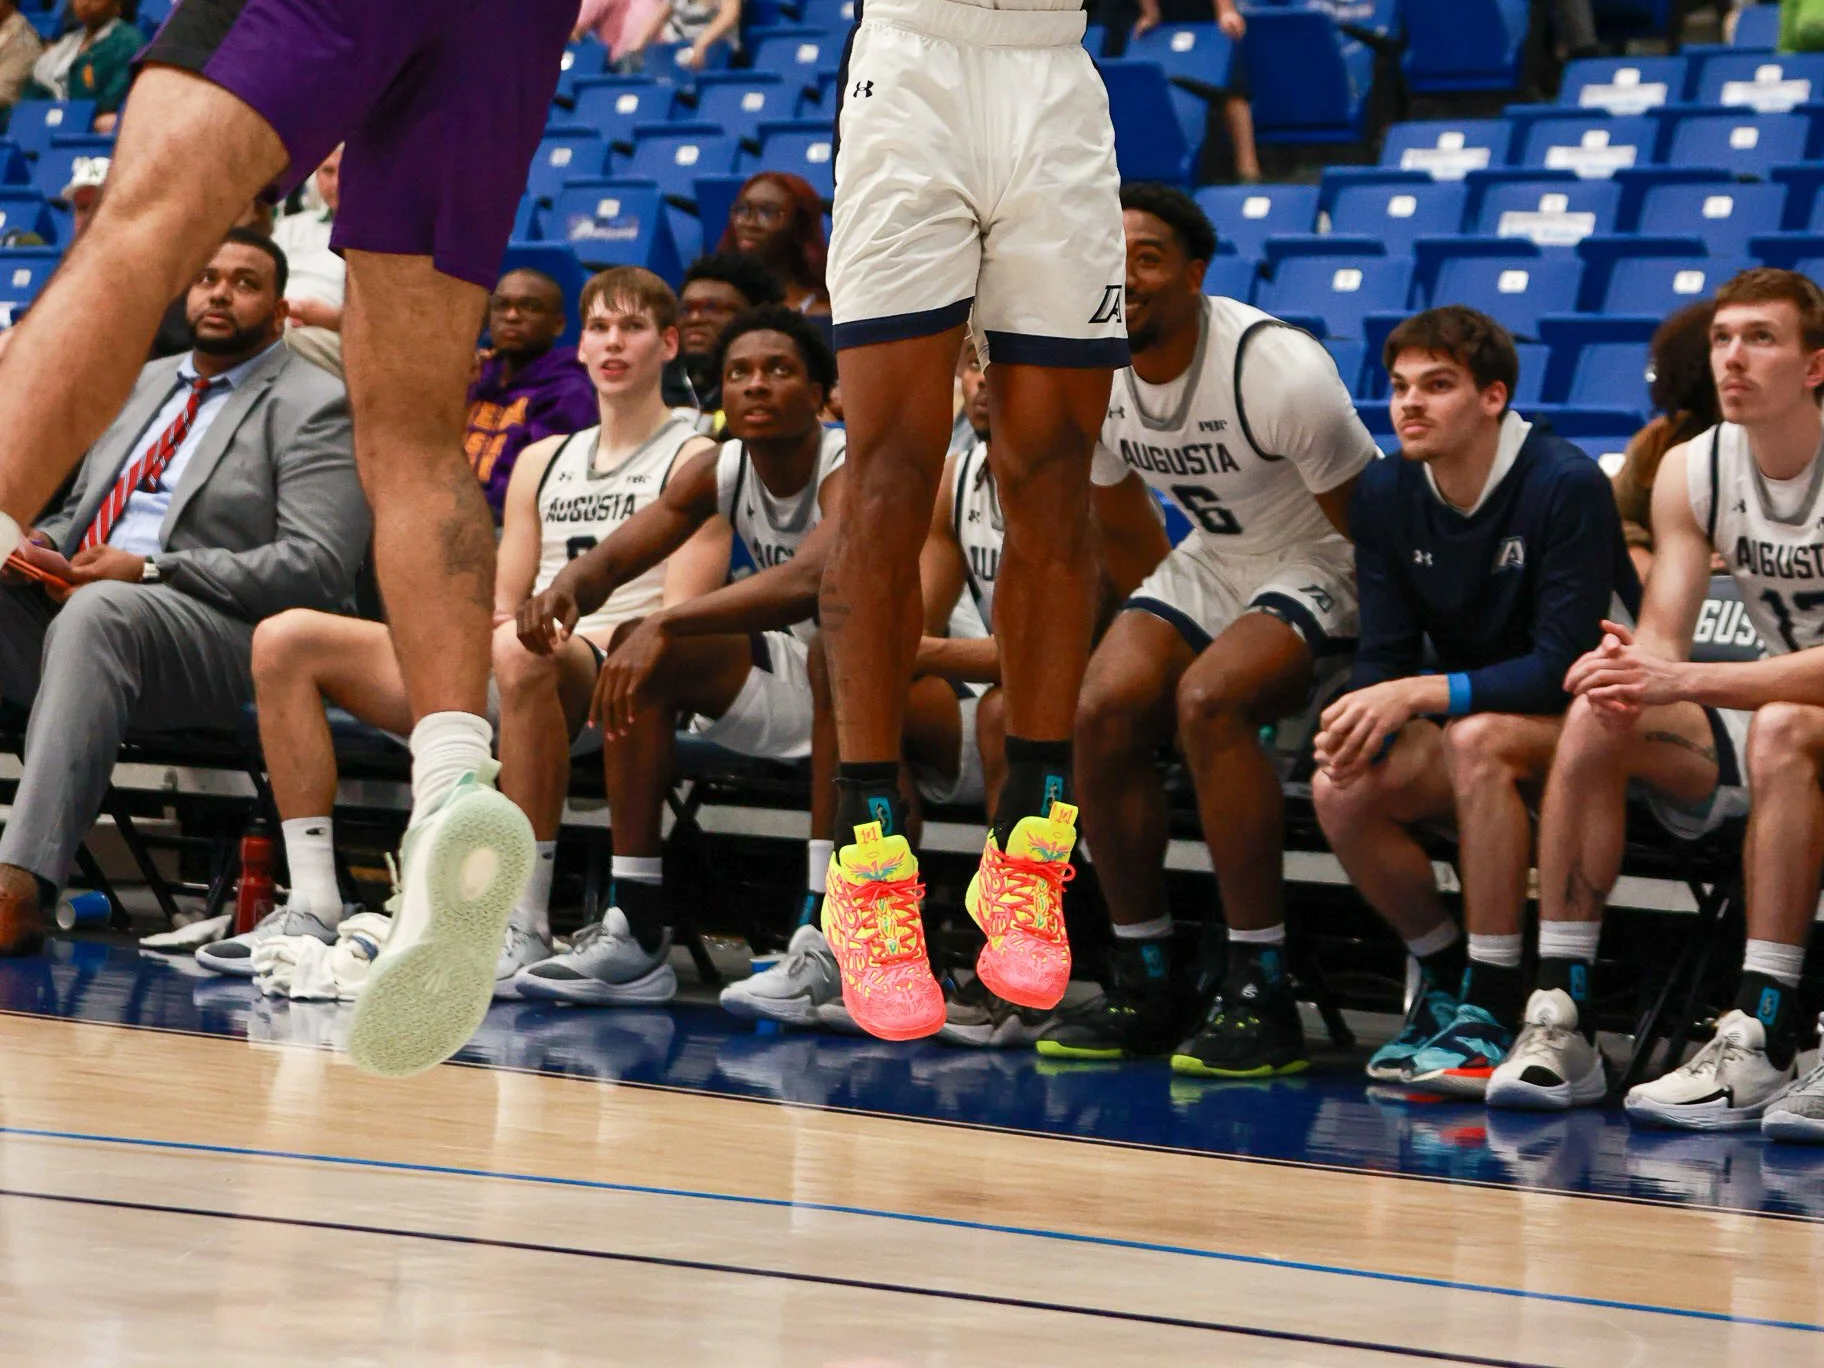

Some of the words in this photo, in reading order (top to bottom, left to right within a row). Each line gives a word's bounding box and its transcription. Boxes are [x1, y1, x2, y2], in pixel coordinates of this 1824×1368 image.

[1119, 438, 1241, 475] AUGUSTA
[545, 493, 636, 523] AUGUSTA
[1170, 484, 1243, 536] 6
